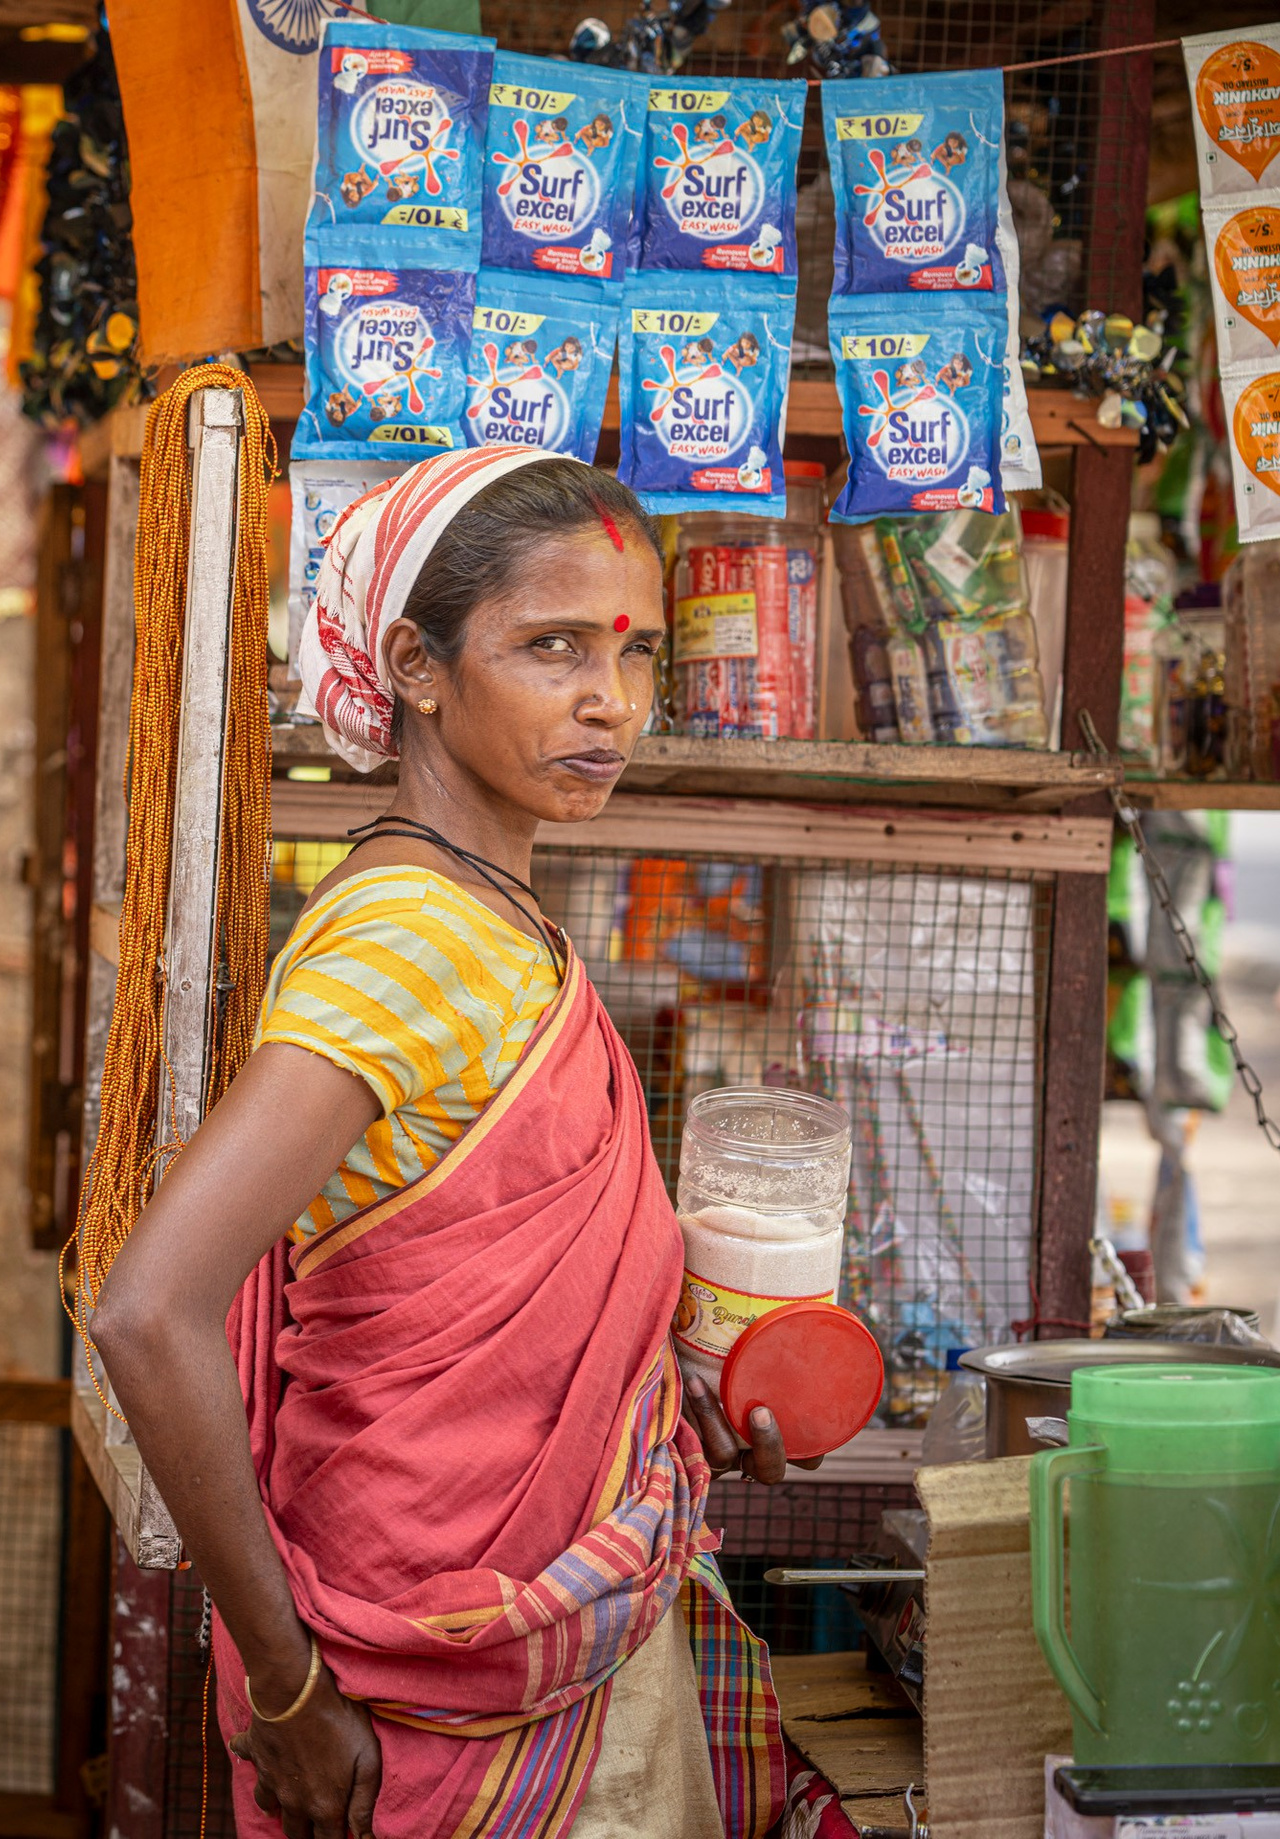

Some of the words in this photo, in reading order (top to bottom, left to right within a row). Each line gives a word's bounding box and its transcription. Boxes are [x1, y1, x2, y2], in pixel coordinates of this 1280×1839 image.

[1222, 81, 1234, 90] OIL
[1236, 78, 1269, 89] MUSTARD
[375, 97, 433, 117] excel
[368, 118, 431, 151] Surf
[520, 163, 584, 200] Surf
[683, 164, 747, 198] Surf
[516, 198, 575, 223] excel
[681, 199, 741, 220] excel
[885, 189, 946, 222] Surf
[514, 219, 540, 232] EASY
[541, 221, 573, 235] WASH
[681, 221, 707, 231] EASY
[710, 222, 739, 232] WASH
[885, 222, 944, 243] excel
[886, 246, 912, 256] EASY
[914, 246, 944, 256] WASH
[359, 319, 417, 337] excel
[351, 339, 414, 371] Surf
[489, 387, 554, 423] Surf
[672, 387, 735, 421] Surf
[485, 421, 545, 445] excel
[670, 422, 730, 443] excel
[888, 411, 951, 444] Surf
[1250, 421, 1280, 437] NiK
[670, 444, 696, 454] EASY
[698, 446, 728, 455] WASH
[888, 445, 947, 465] excel
[888, 467, 915, 479] EASY
[917, 468, 947, 477] WASH
